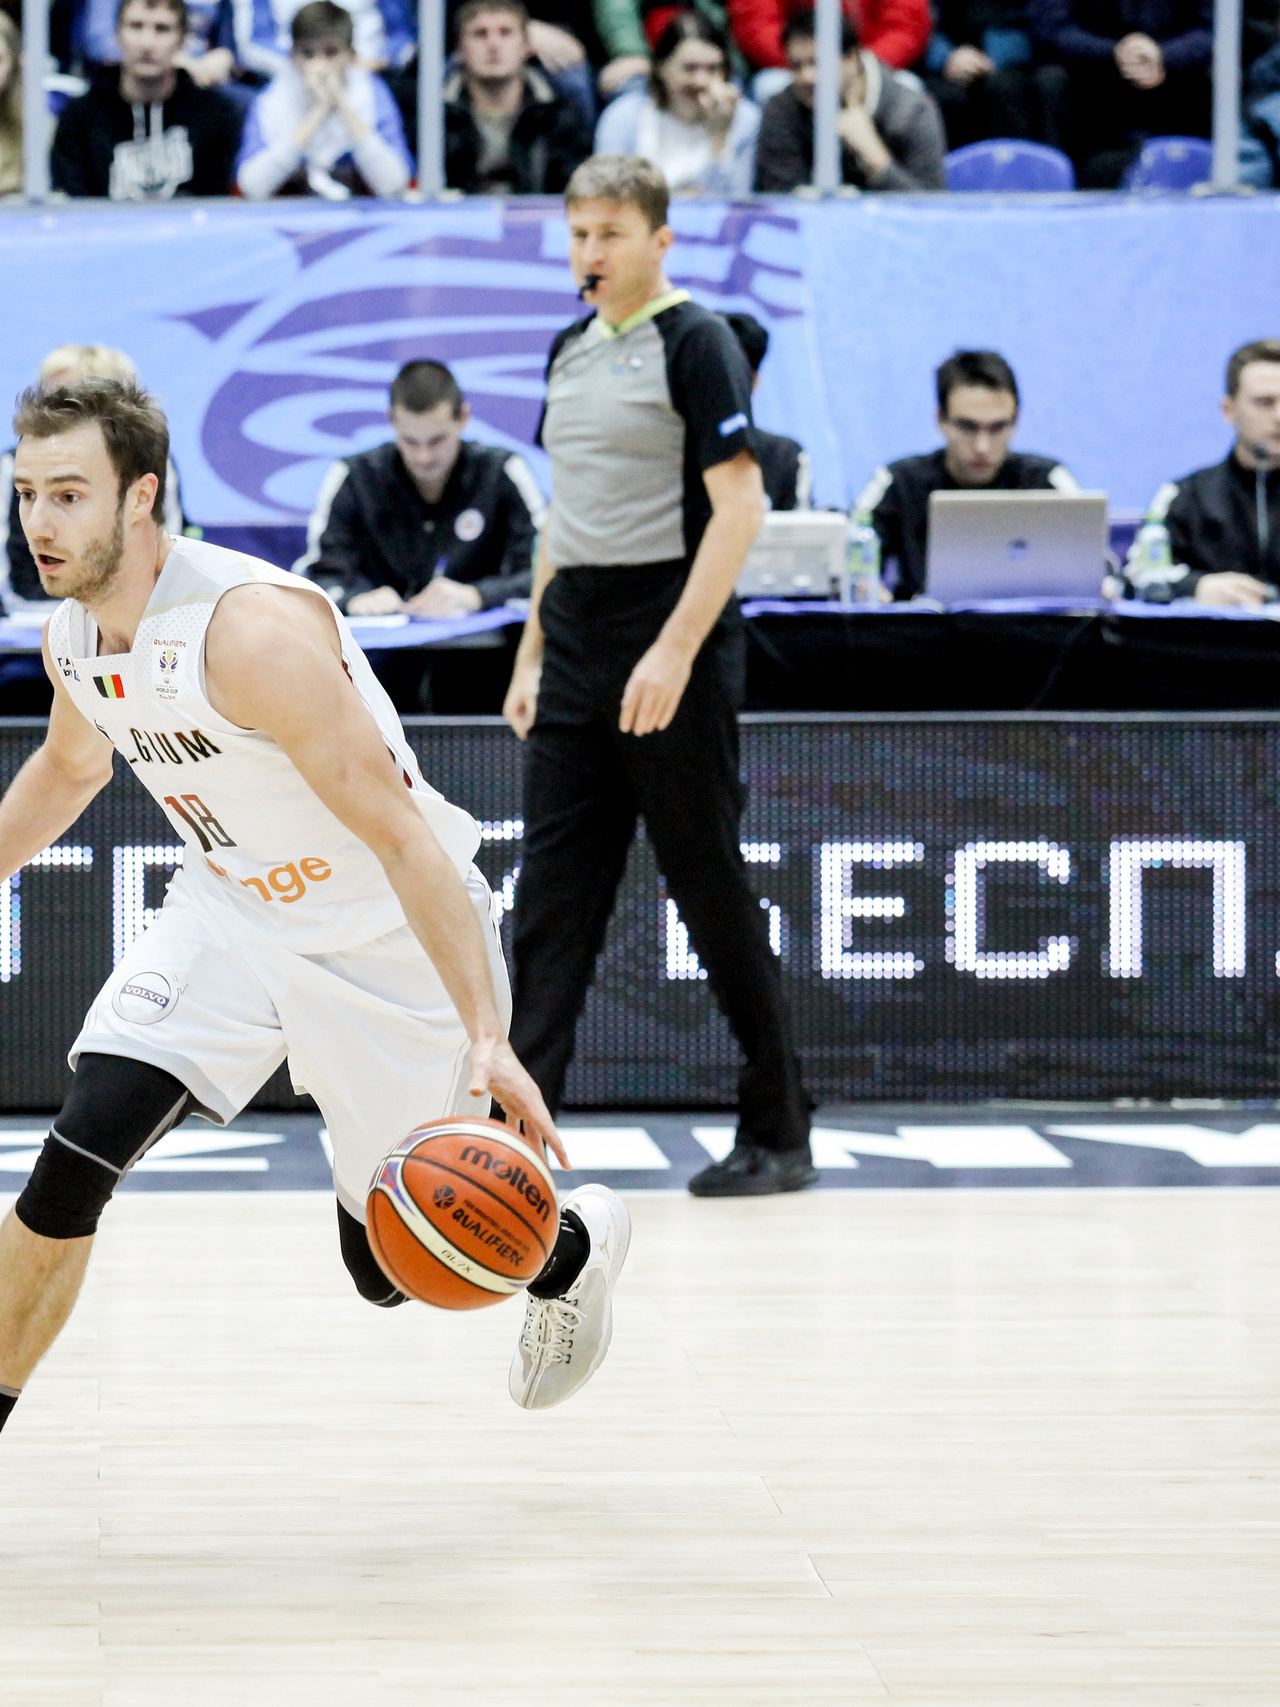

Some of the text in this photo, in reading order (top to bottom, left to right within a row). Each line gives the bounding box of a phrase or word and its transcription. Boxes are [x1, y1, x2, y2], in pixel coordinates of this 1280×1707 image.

[164, 794, 238, 854] 18
[124, 985, 167, 1006] VOLVO
[459, 1145, 551, 1223] molten
[451, 1207, 524, 1268] QUALIFIERS
